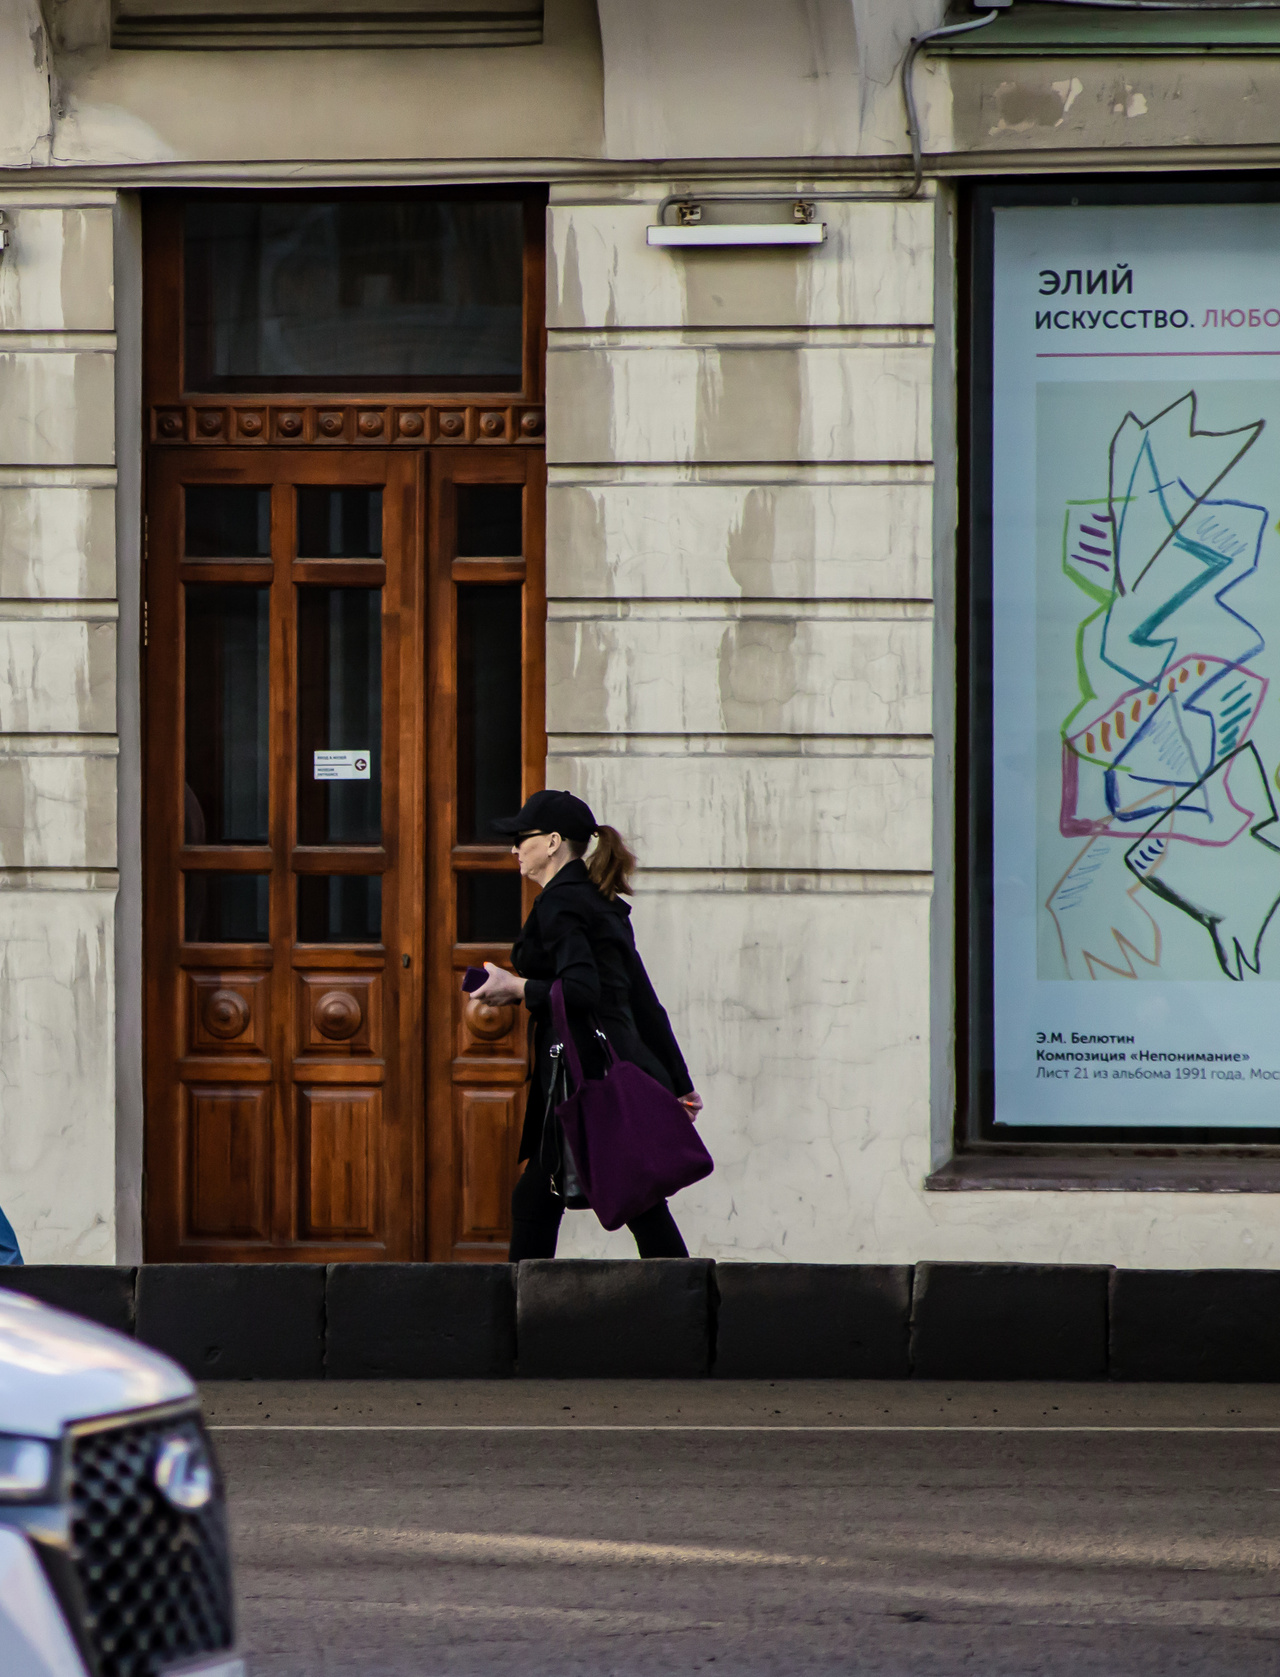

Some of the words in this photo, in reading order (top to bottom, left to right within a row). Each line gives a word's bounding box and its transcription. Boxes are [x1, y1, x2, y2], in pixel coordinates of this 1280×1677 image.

[1038, 263, 1133, 295] ЭЛИЙ
[1034, 309, 1195, 329] ИСКУССТВО.
[1035, 1032, 1067, 1044] Э.М.
[1071, 1032, 1135, 1044] Белютин
[1035, 1050, 1126, 1062] Композиция
[1130, 1050, 1251, 1062] «Непонимание»
[1035, 1067, 1070, 1079] Лист
[1073, 1067, 1089, 1079] 21
[1093, 1070, 1109, 1079] из
[1112, 1067, 1171, 1080] альбома
[1175, 1068, 1207, 1080] 1991
[1211, 1070, 1246, 1080] года,
